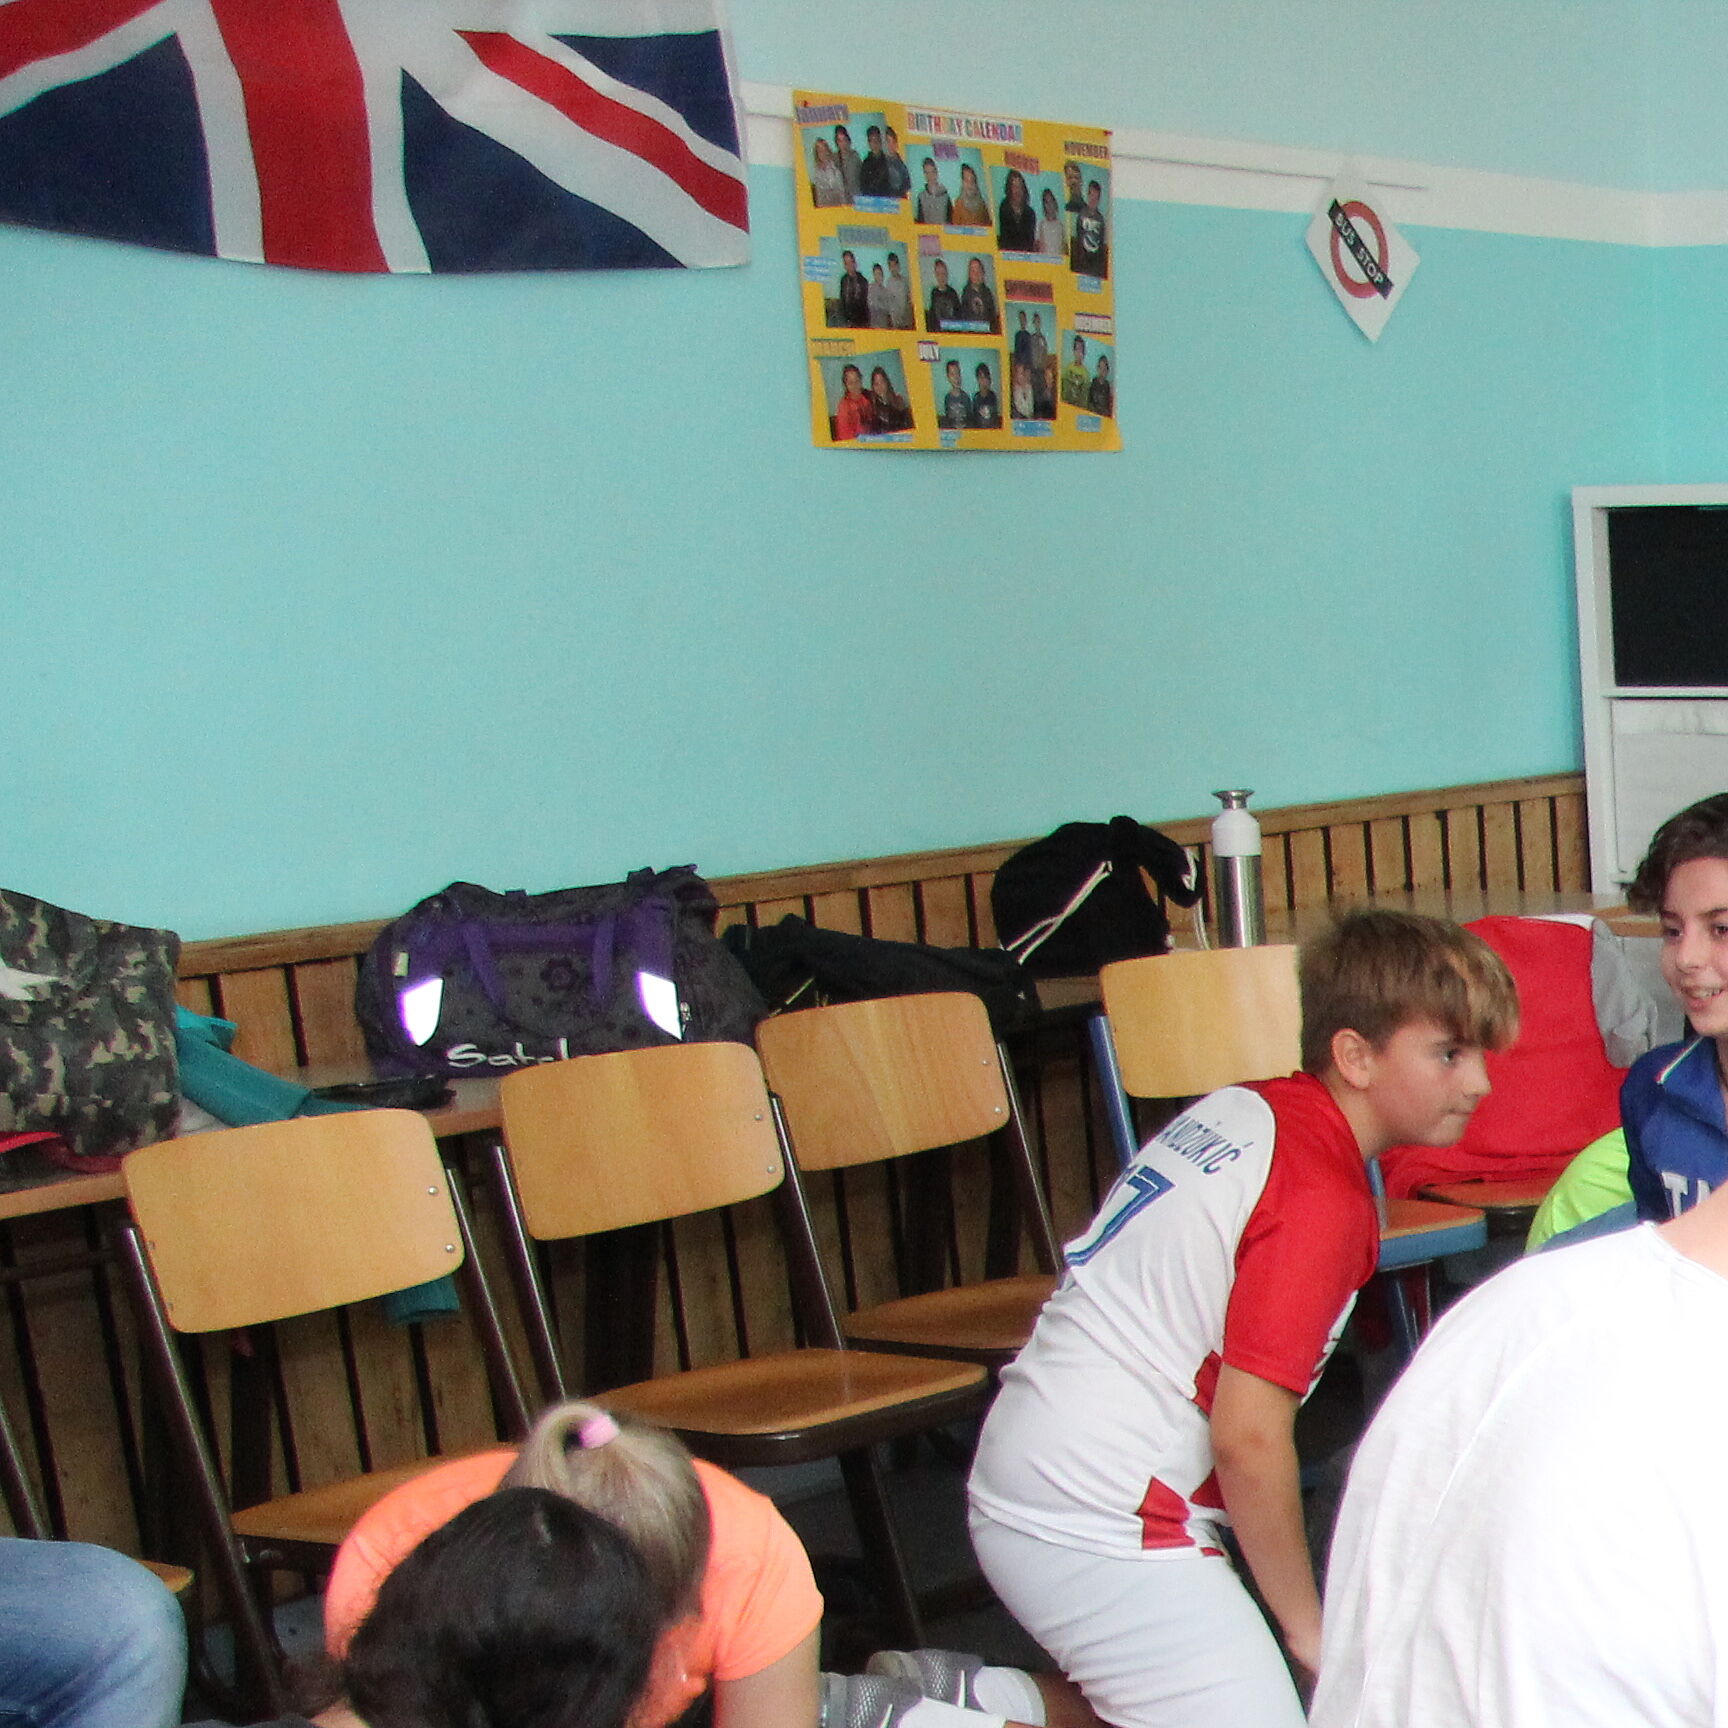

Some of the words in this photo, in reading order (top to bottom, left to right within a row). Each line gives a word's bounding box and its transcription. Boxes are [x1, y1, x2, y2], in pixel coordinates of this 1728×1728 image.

[907, 112, 964, 137] BIRTHDAY
[965, 118, 1021, 143] CALENDAR
[1334, 212, 1356, 245] BUS
[1357, 246, 1385, 284] STOP
